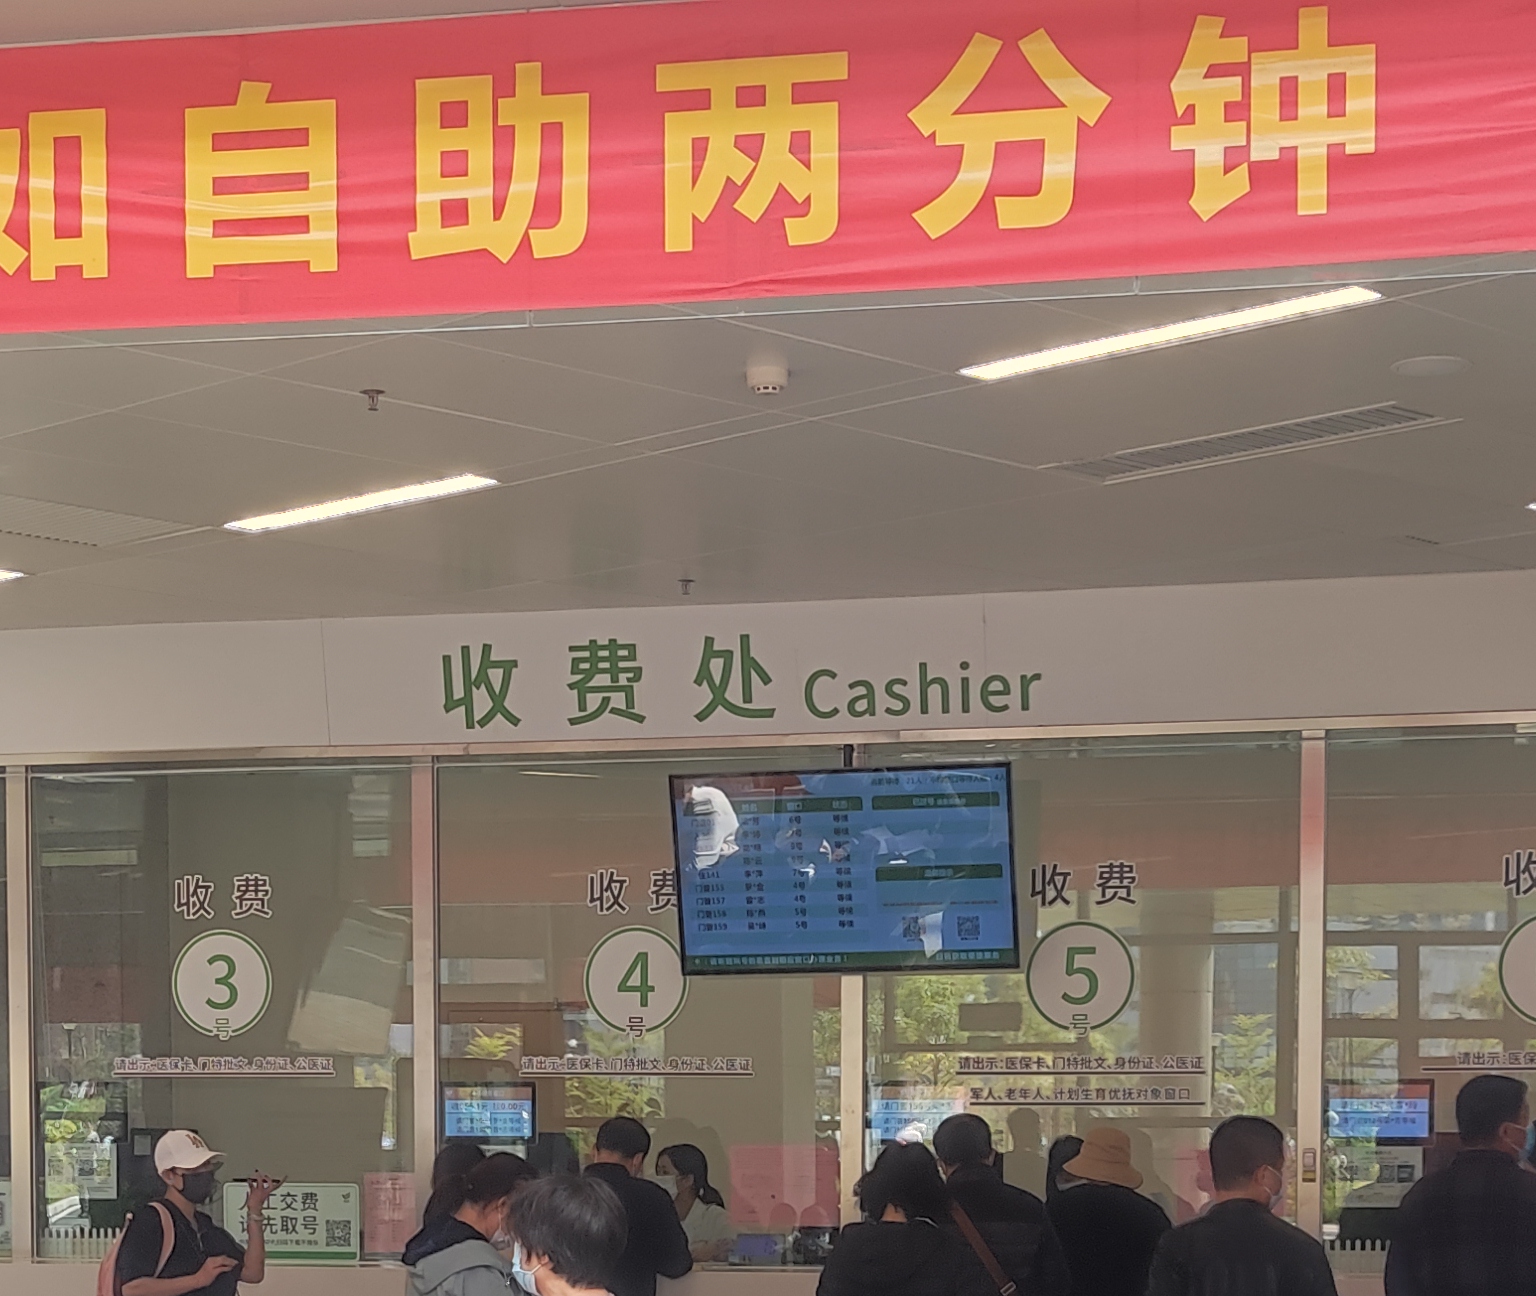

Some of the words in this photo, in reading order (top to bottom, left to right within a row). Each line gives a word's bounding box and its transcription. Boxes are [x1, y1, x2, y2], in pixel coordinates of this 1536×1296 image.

[442, 633, 777, 730] 收费处
[804, 661, 1043, 719] Cashier
[174, 874, 272, 920] 收费
[1030, 861, 1139, 908] 收费
[206, 954, 239, 1010] 3
[616, 950, 655, 1009] 4
[1061, 946, 1100, 1005] 5
[211, 1016, 233, 1040] 号
[625, 1016, 648, 1038] 号
[1070, 1012, 1090, 1038] 号
